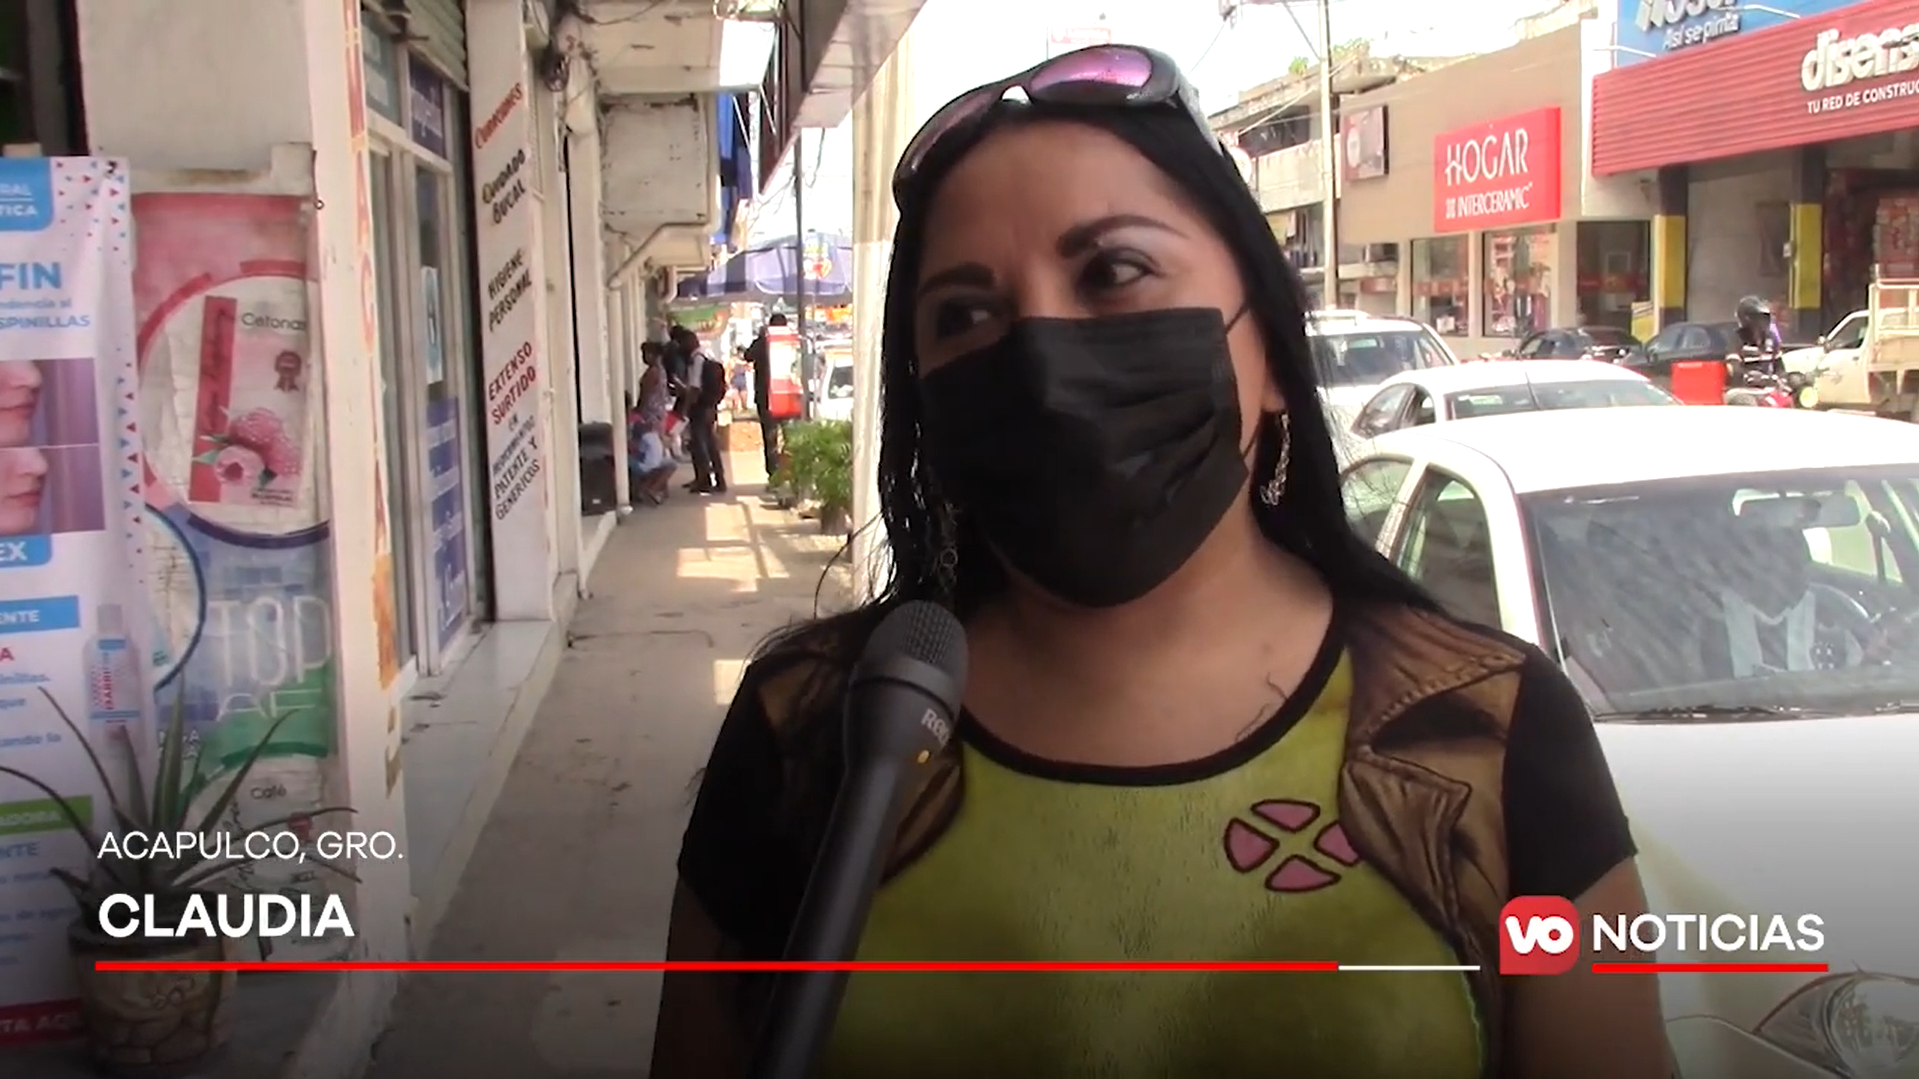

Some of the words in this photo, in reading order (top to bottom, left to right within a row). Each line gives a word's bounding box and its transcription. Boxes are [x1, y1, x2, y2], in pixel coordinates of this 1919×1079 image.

[1807, 99, 1821, 114] TU
[1822, 95, 1843, 111] RED
[1845, 91, 1861, 107] DE
[1445, 127, 1529, 187] HOGAR
[489, 268, 533, 334] PERSONAL
[488, 340, 533, 401] EXTENSO
[491, 365, 537, 425] SURTIDO
[494, 447, 528, 499] PATENTE
[528, 434, 538, 450] Y
